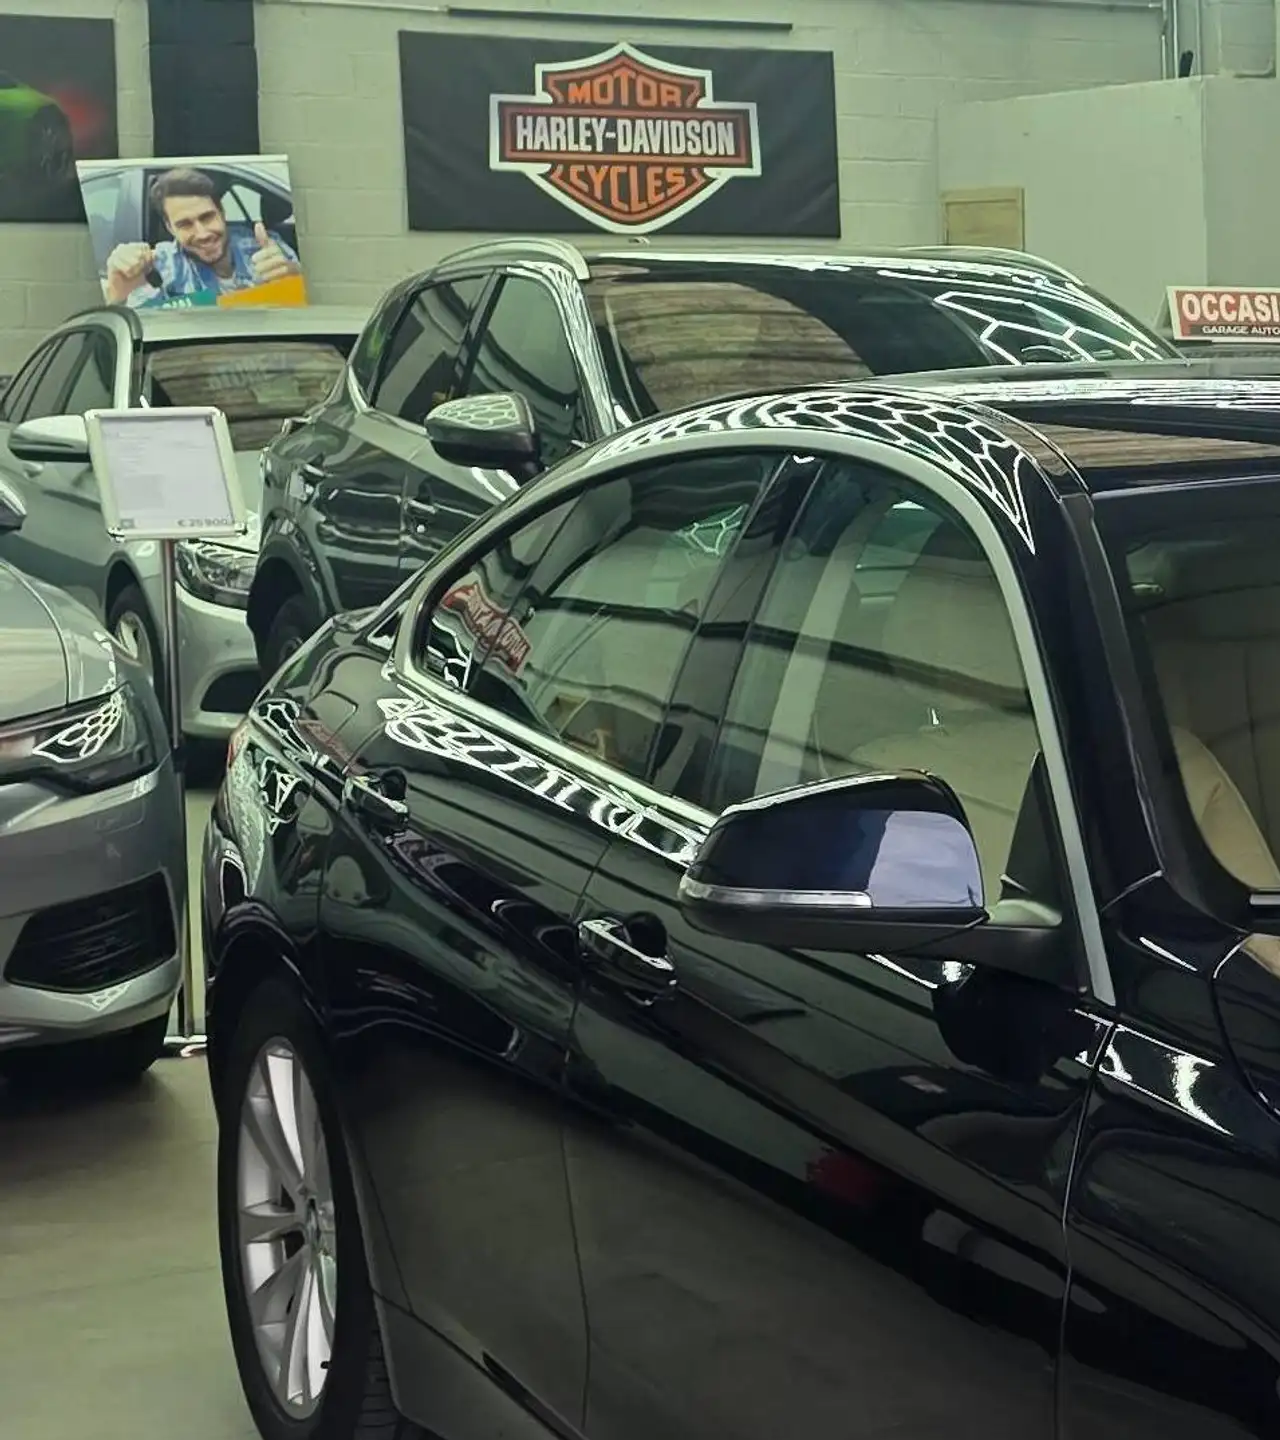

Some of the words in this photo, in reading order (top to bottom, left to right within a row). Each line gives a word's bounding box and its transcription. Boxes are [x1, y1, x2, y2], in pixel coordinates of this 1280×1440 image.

[568, 68, 682, 107] MOTOR
[516, 115, 735, 155] HARLEY-DAVIDSON
[569, 163, 686, 212] CYCLES
[1202, 325, 1249, 334] GARAGE
